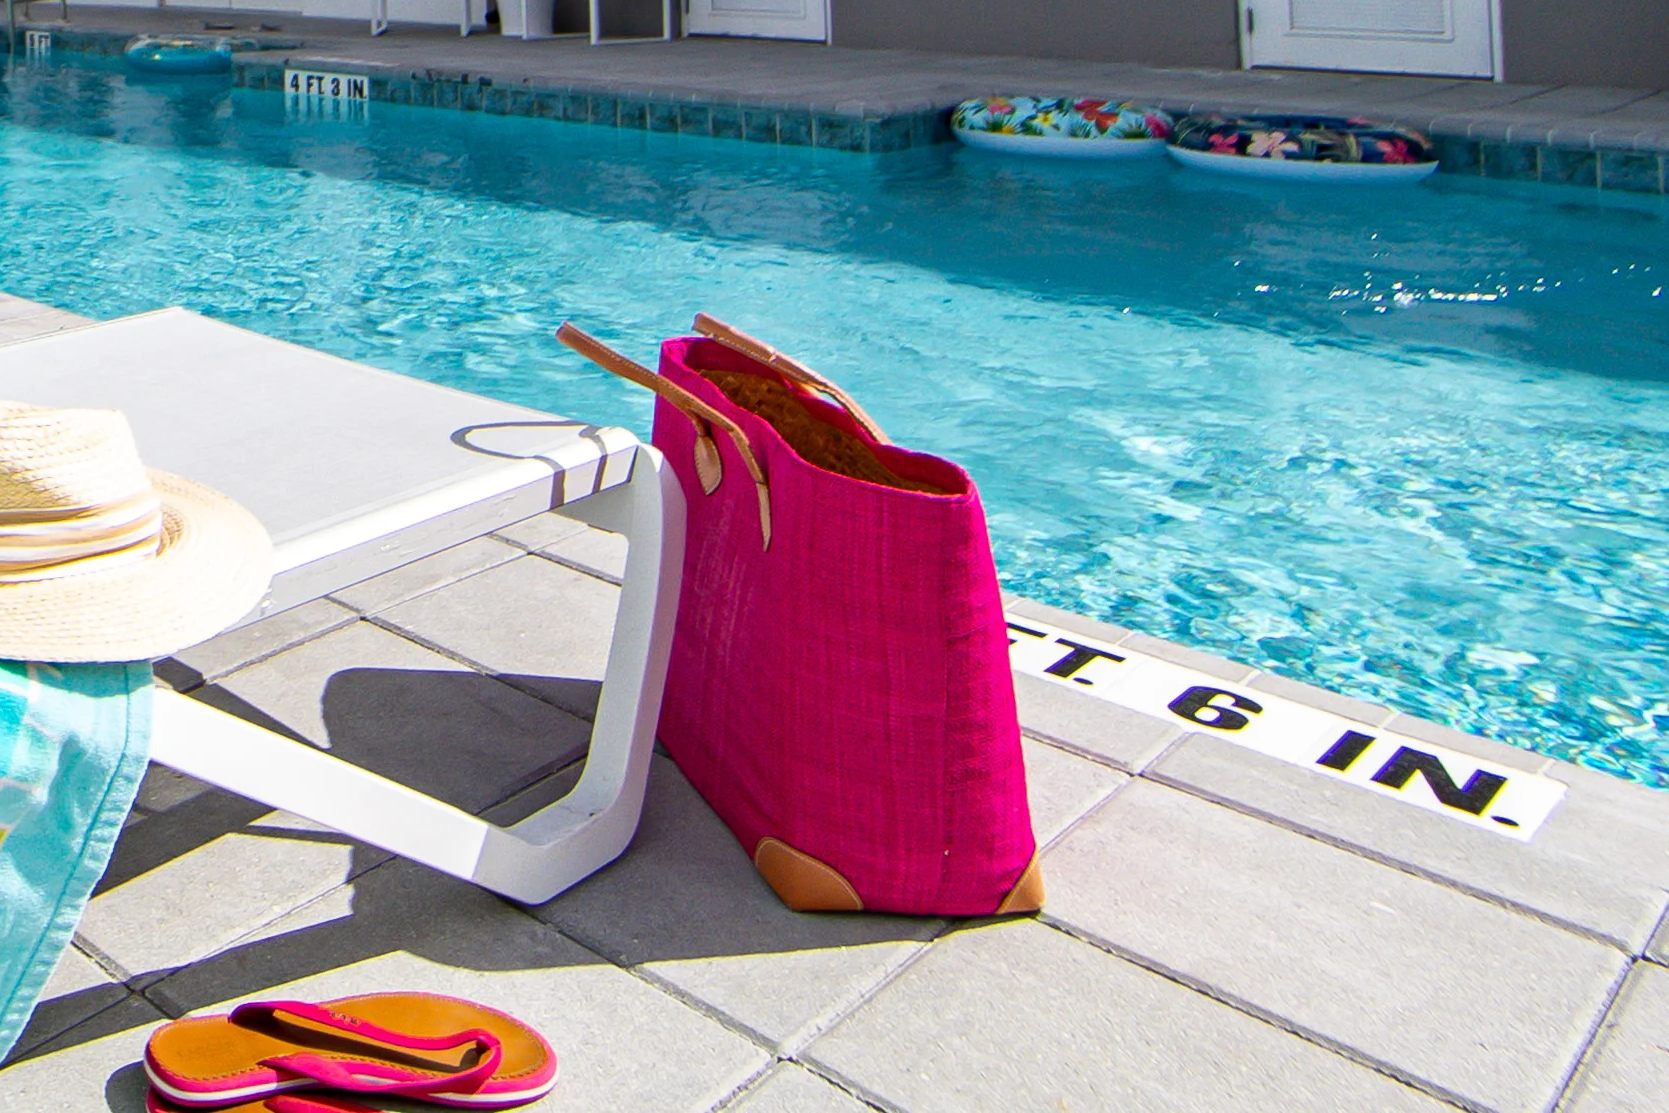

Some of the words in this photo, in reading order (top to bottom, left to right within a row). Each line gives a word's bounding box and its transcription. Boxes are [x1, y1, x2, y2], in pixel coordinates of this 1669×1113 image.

[290, 73, 301, 92] 4
[331, 77, 341, 97] 3
[1167, 685, 1263, 731] 6
[1315, 728, 1521, 828] IN.
